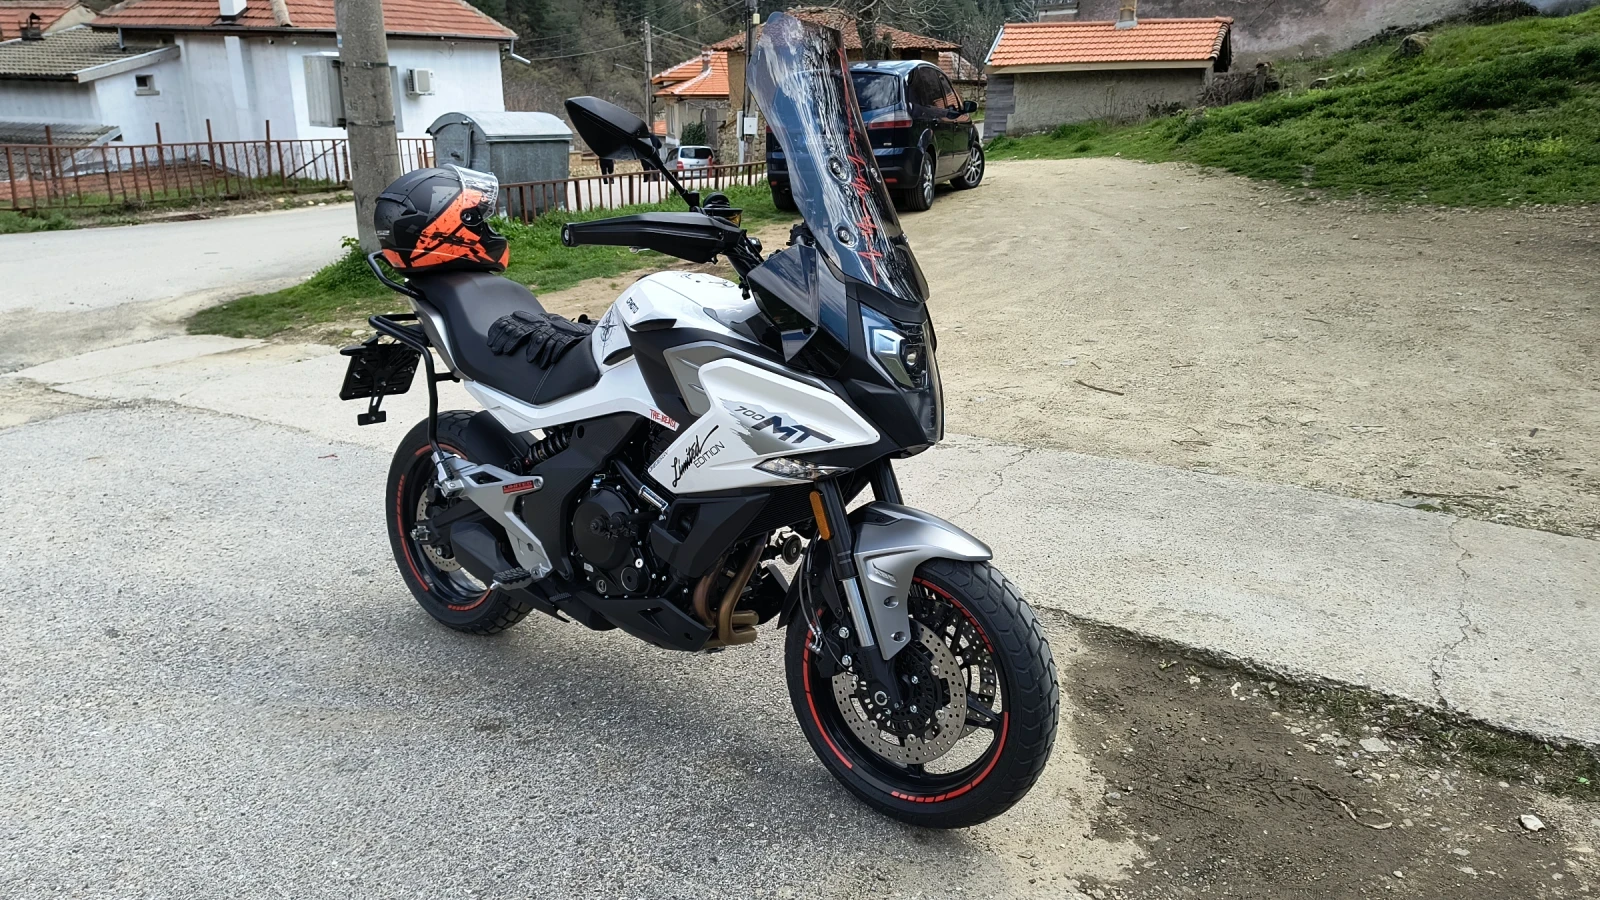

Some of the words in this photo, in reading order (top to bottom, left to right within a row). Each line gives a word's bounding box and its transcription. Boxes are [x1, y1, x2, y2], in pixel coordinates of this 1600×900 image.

[734, 405, 766, 421] 700
[751, 415, 836, 444] MT
[671, 424, 719, 488] Limited
[693, 440, 725, 469] EDITION
